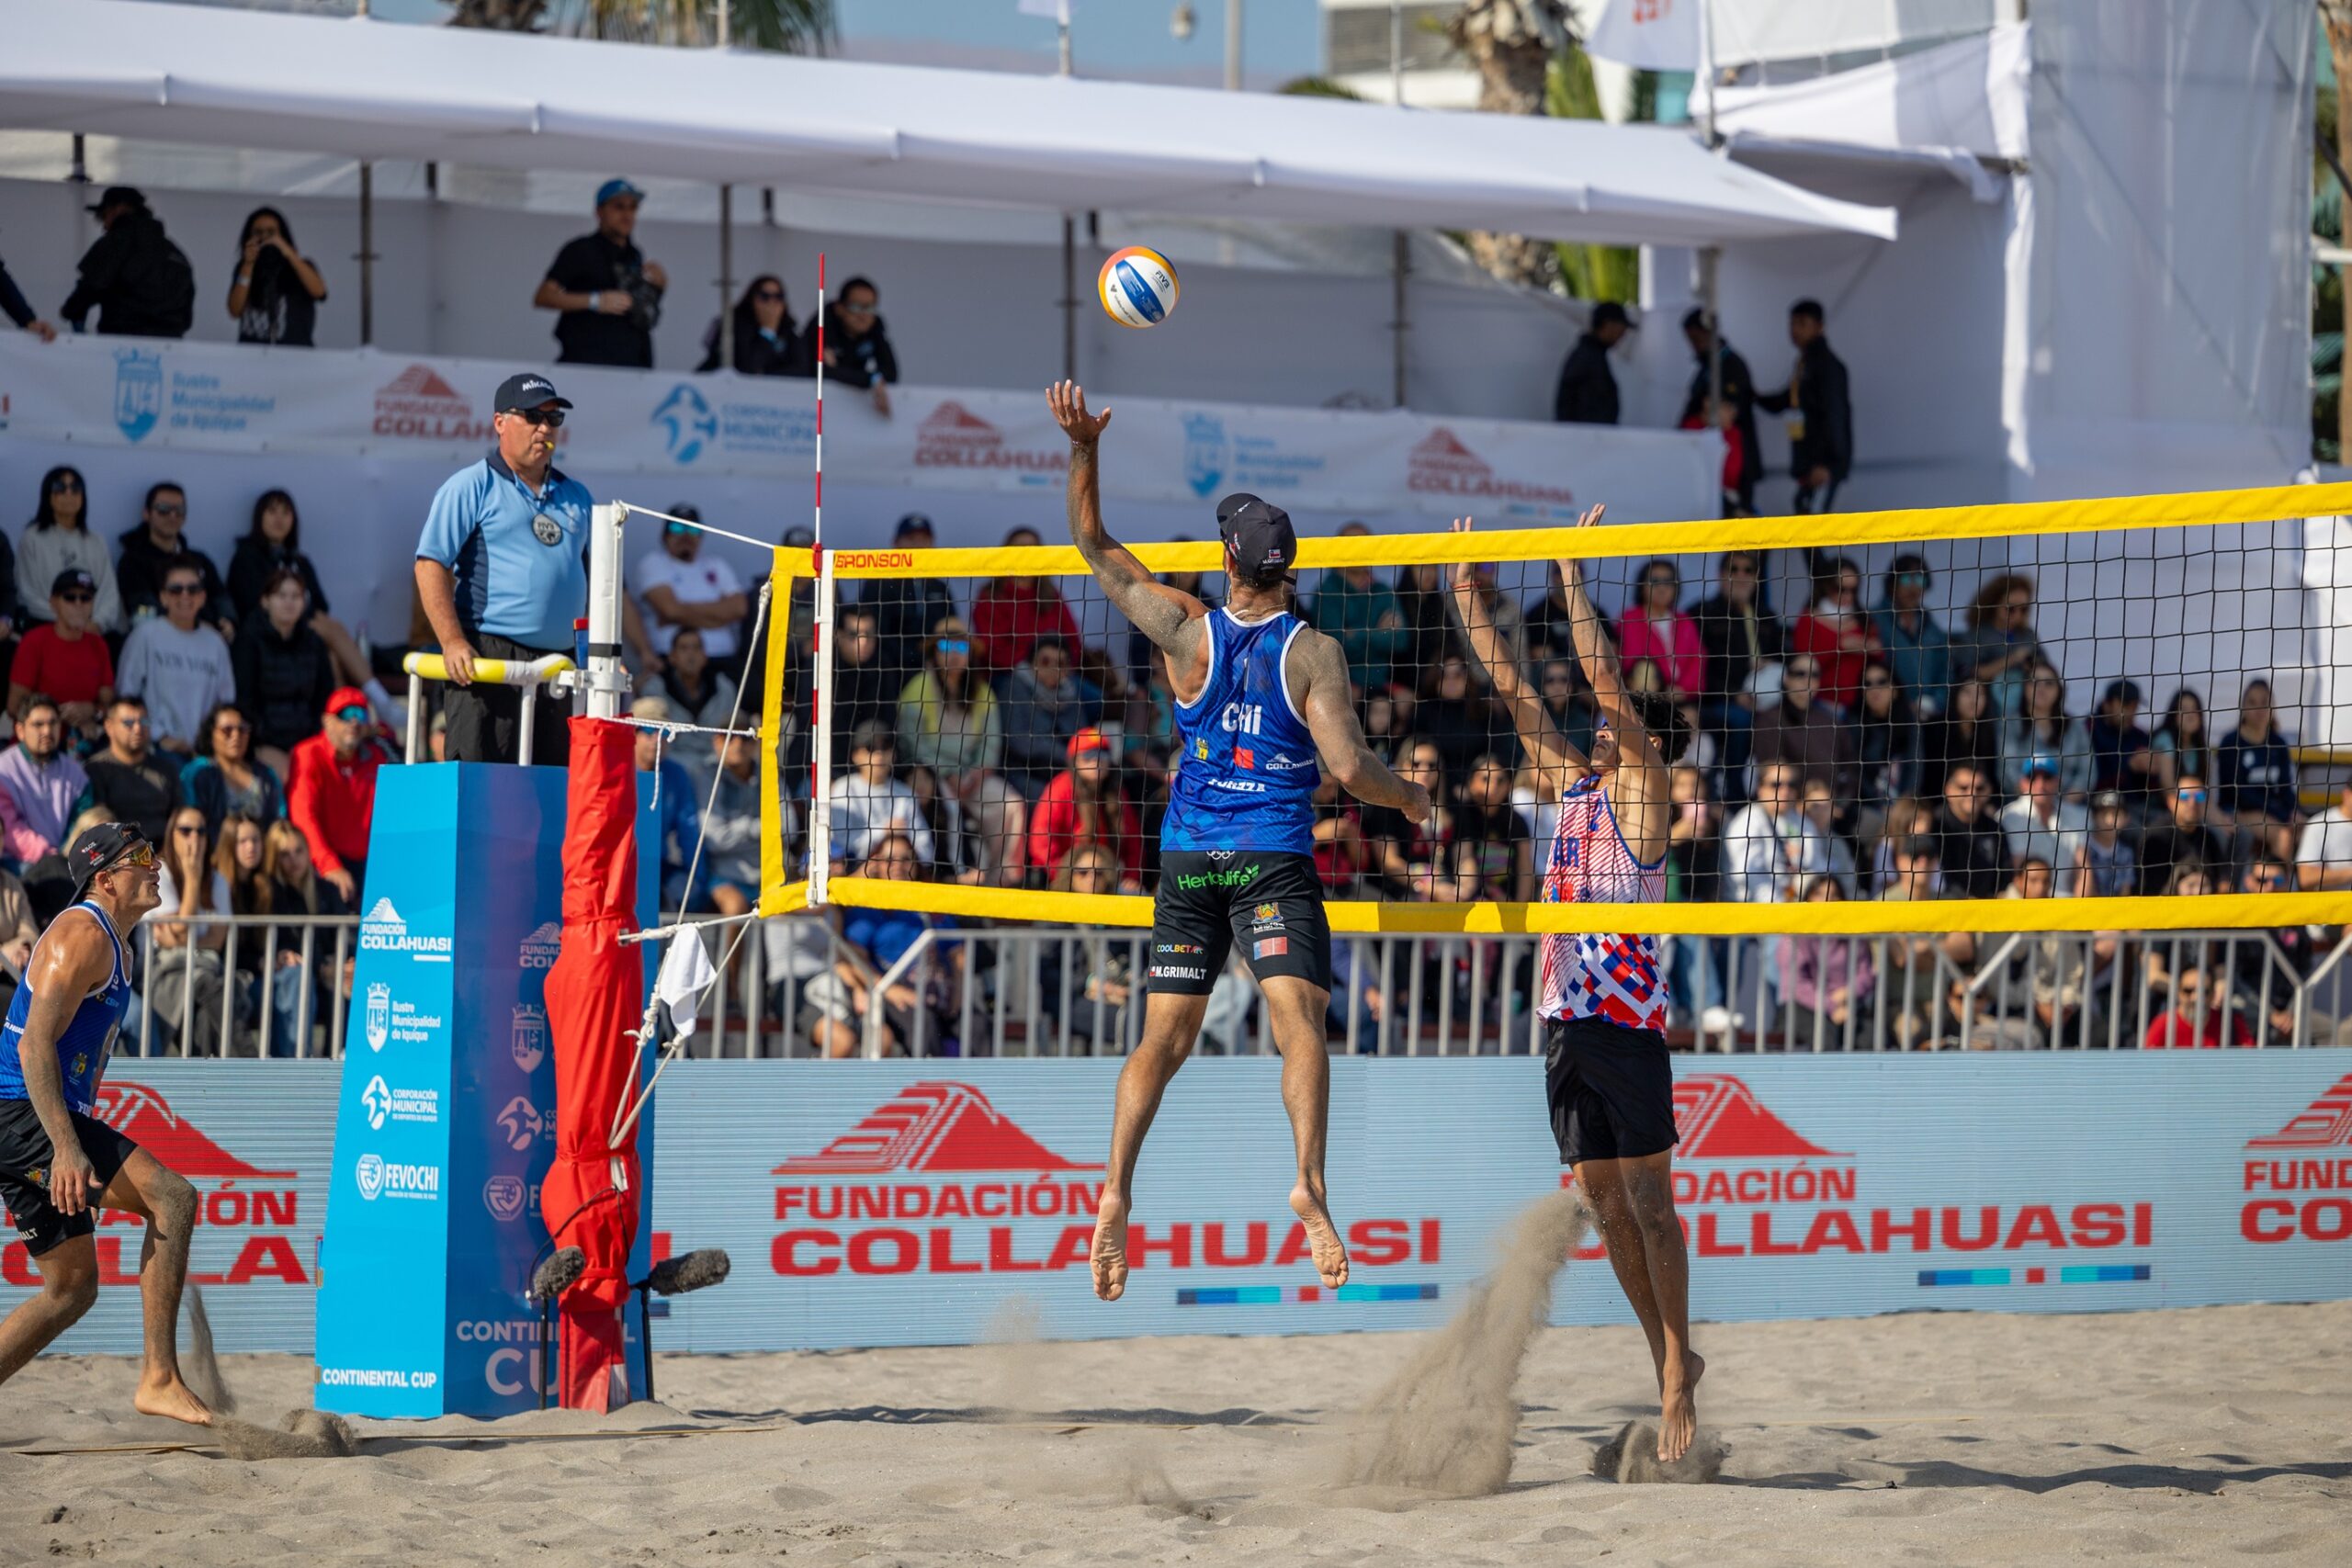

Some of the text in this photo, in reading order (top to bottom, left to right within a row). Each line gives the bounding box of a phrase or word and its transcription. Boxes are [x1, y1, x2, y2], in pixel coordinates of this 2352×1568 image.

[914, 446, 1070, 471] COLLAHUA
[1222, 701, 1262, 735] CHI
[362, 922, 407, 936] FUNDACIÓN
[361, 935, 452, 952] COLLAHUASI
[520, 944, 562, 956] FUNDAC
[393, 1088, 438, 1100] CORPORACIÓN
[393, 1100, 438, 1114] MUNICIPAL
[385, 1163, 439, 1191] FEVOCHI
[322, 1368, 437, 1388] CONTINENTAL CUP
